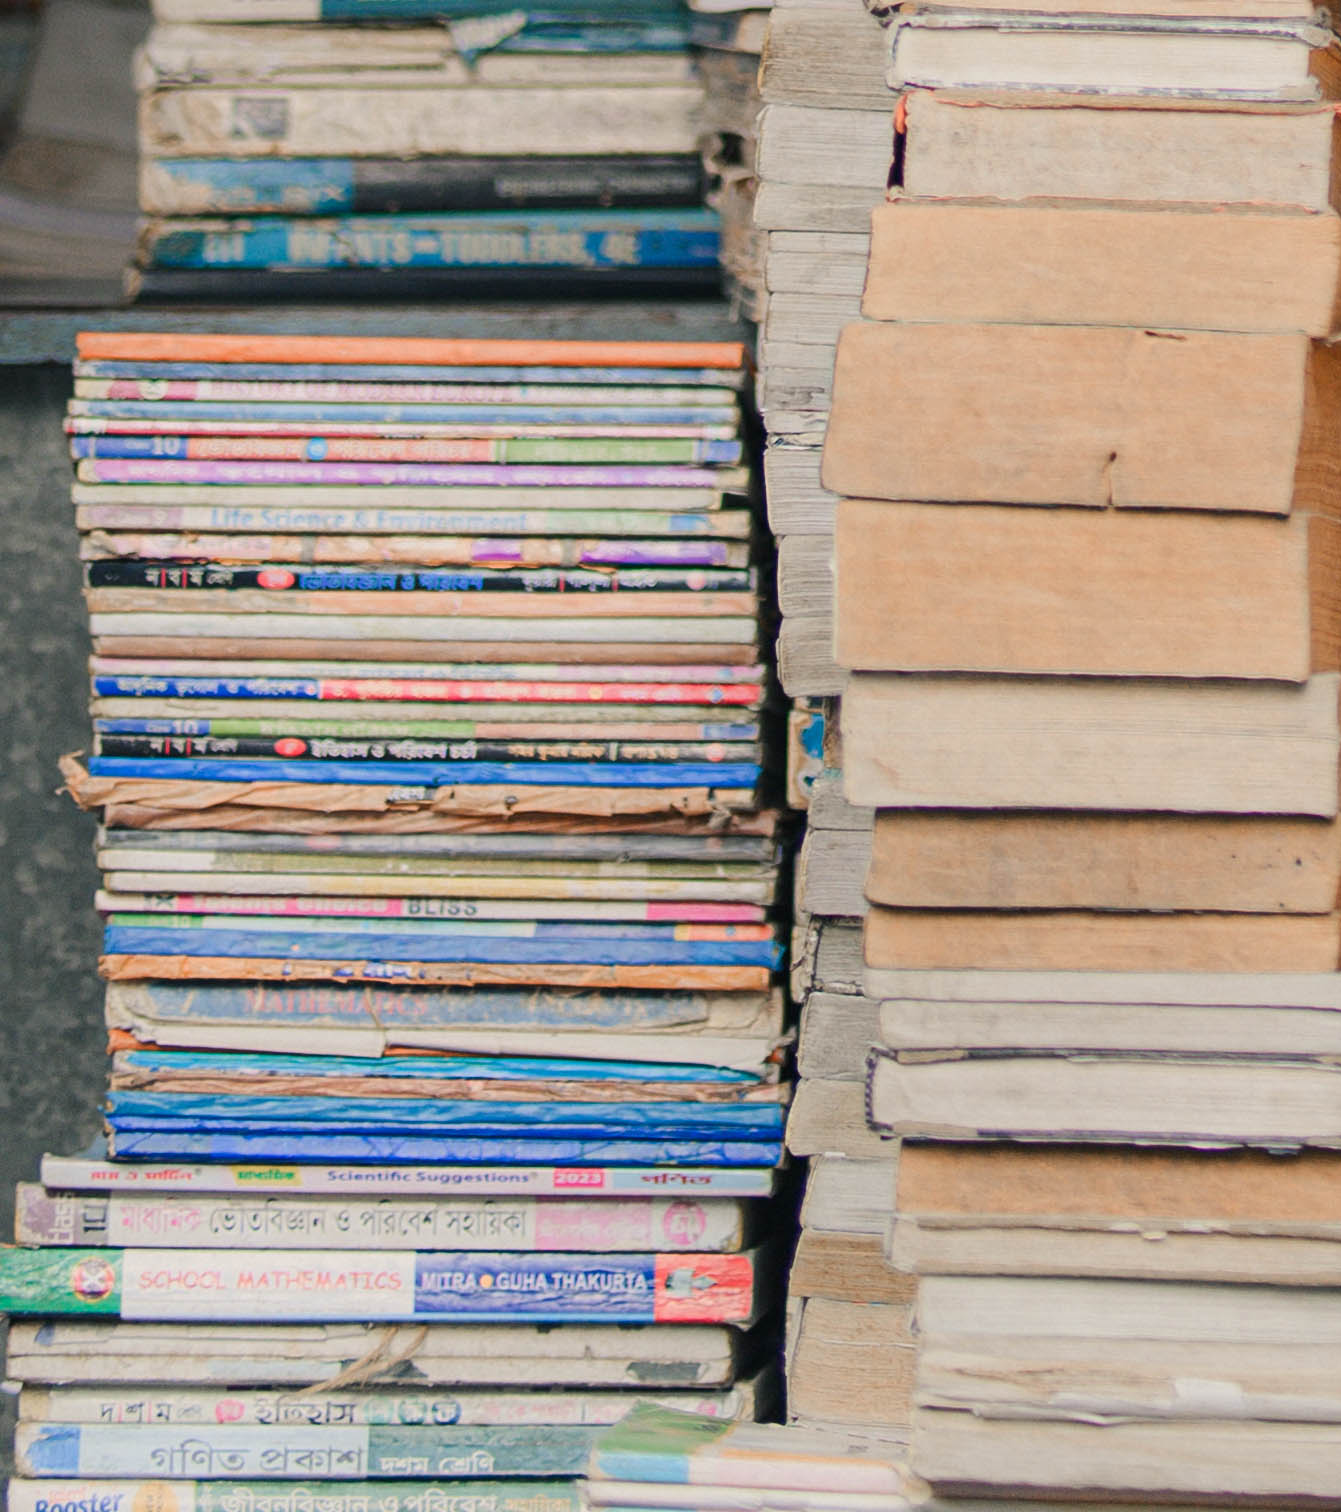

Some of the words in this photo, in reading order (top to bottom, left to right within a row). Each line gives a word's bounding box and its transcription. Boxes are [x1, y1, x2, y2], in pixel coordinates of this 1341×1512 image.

[211, 508, 254, 528] Life
[256, 508, 344, 529] Science
[377, 510, 527, 531] Environment
[408, 899, 478, 916] BLISS
[327, 1170, 411, 1182] Scientific
[415, 1171, 529, 1184] Suggestions
[139, 1270, 225, 1290] SCHOOL
[237, 1270, 403, 1291] MATHEMATICS
[422, 1271, 476, 1290] MITRA
[496, 1272, 547, 1291] GUHA
[552, 1272, 648, 1291] THAKURTA
[151, 1438, 250, 1473] গণিত
[260, 1444, 363, 1473] প্রকাশ
